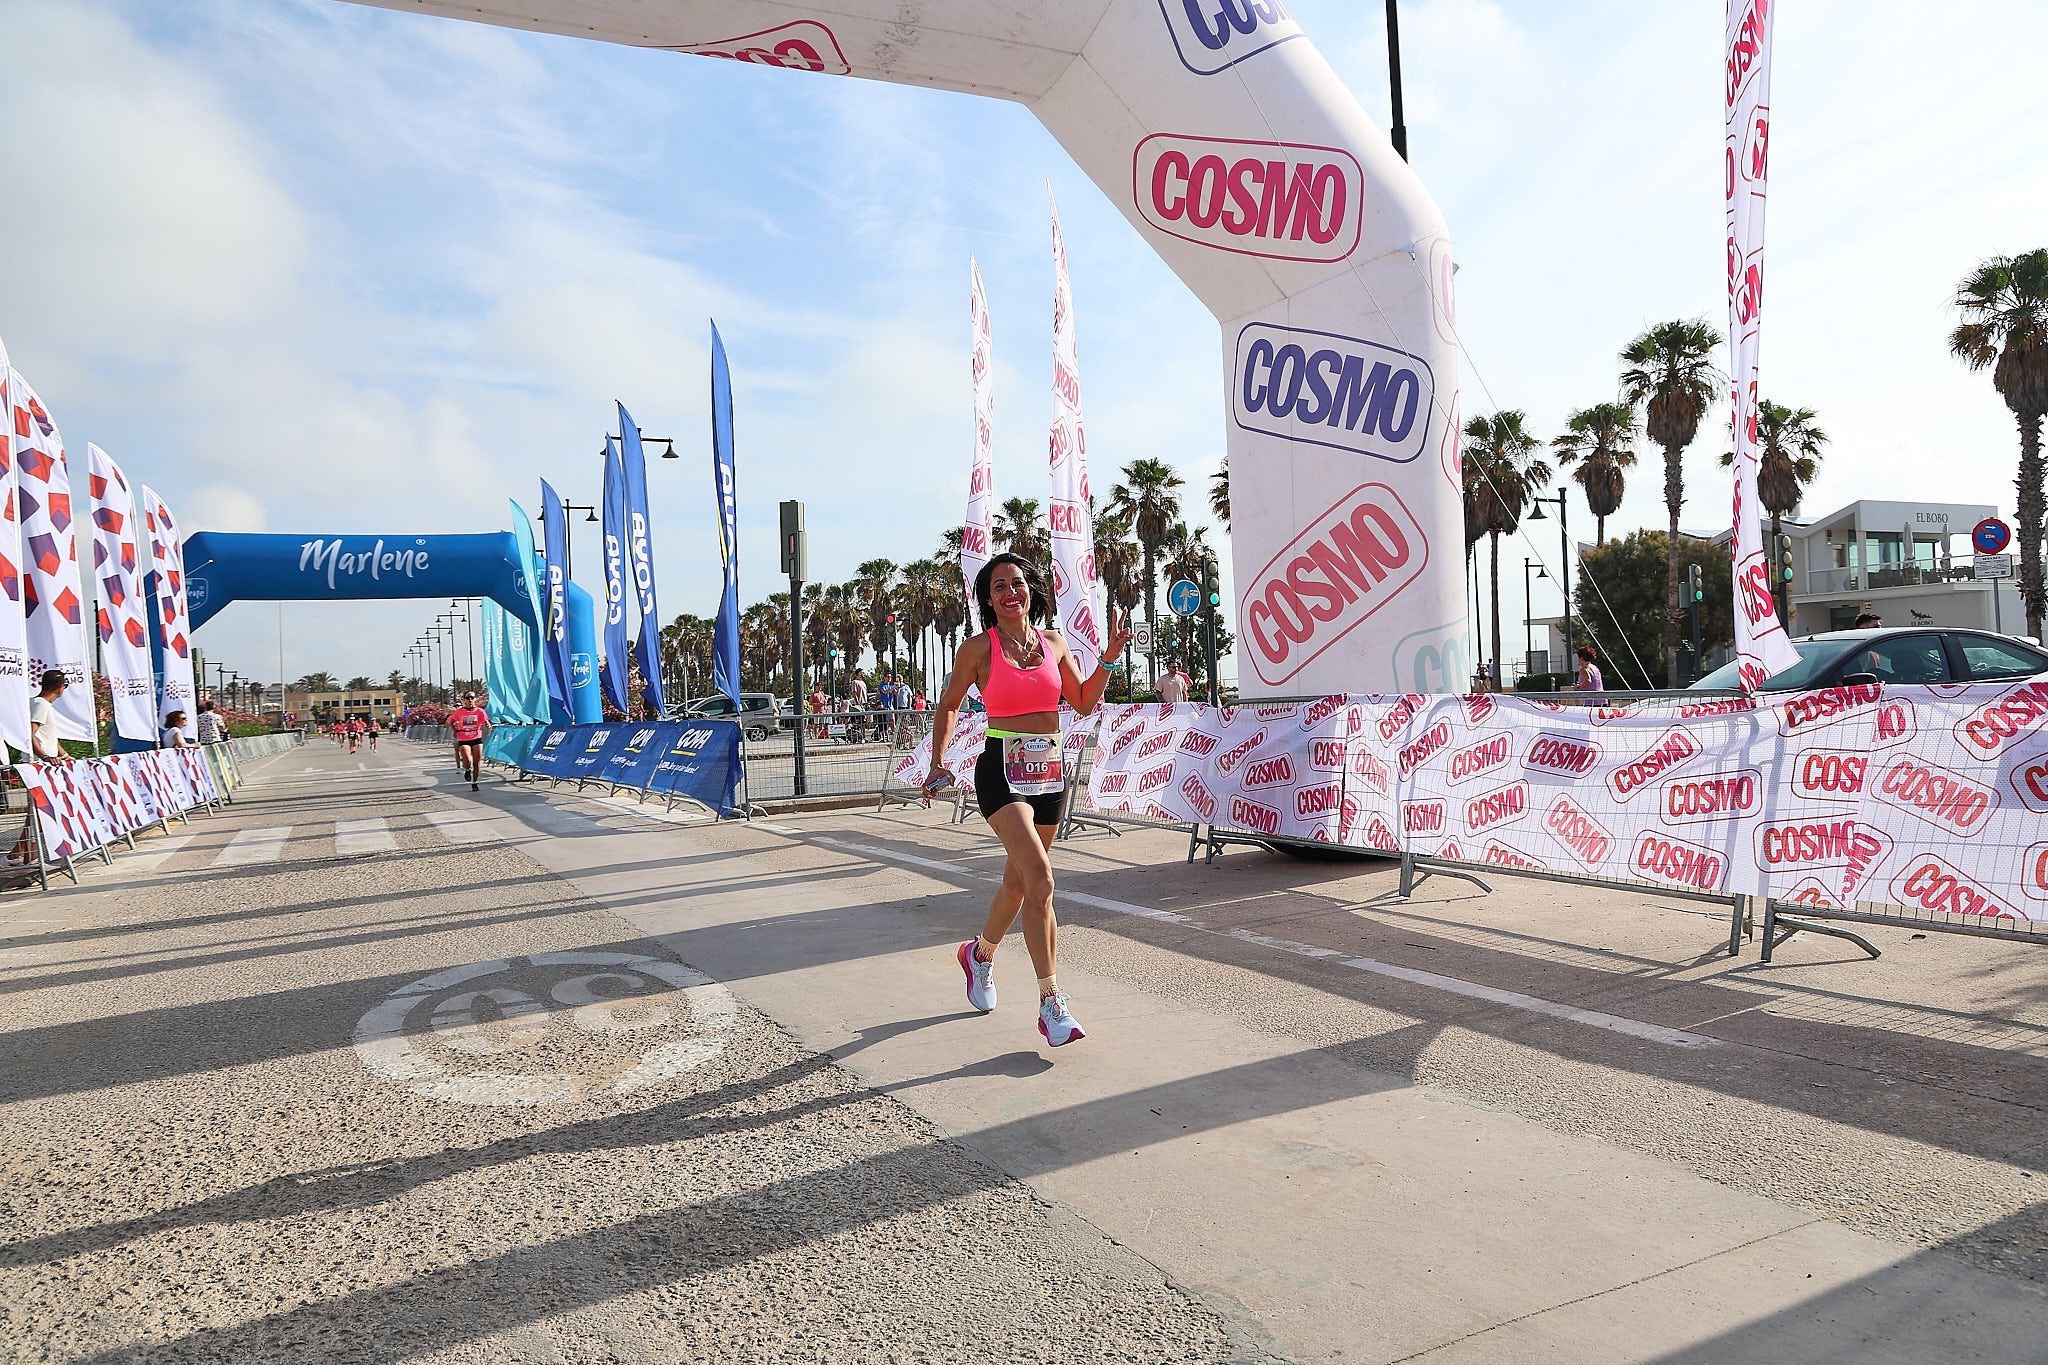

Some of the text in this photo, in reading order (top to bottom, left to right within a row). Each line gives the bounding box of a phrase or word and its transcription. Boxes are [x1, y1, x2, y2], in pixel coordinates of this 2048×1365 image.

[1151, 150, 1346, 244] COSMO
[1243, 338, 1419, 443] COSMO
[1916, 513, 1949, 523] EL BOBO
[1248, 502, 1410, 665] COSMO
[1965, 681, 2048, 750] COSM
[676, 728, 713, 750] GOYA
[1112, 720, 1146, 755] COSMO
[1138, 730, 1173, 759] COSMO
[1179, 730, 1217, 756] COSMO
[1219, 731, 1264, 772] COSMO
[1399, 721, 1449, 775] COSMO
[1451, 736, 1508, 781] COSMO
[1528, 738, 1597, 773] COSMO
[1025, 762, 1049, 773] 016
[1100, 774, 1127, 793] COSMO
[1139, 763, 1172, 793] COSMO
[1245, 756, 1291, 786] COSMO
[1354, 748, 1389, 794] COSMO
[1613, 732, 1694, 794] COSMO
[1182, 774, 1215, 819] COSMO
[1297, 784, 1340, 815] COSMO
[1467, 784, 1525, 830] COSMO
[1668, 775, 1754, 818] COSMO
[1881, 760, 1989, 828] COSMO
[1232, 799, 1278, 835] COSMO
[1403, 802, 1443, 832] COSMO
[1548, 800, 1610, 865] COSMO
[1637, 837, 1720, 890] COSMO
